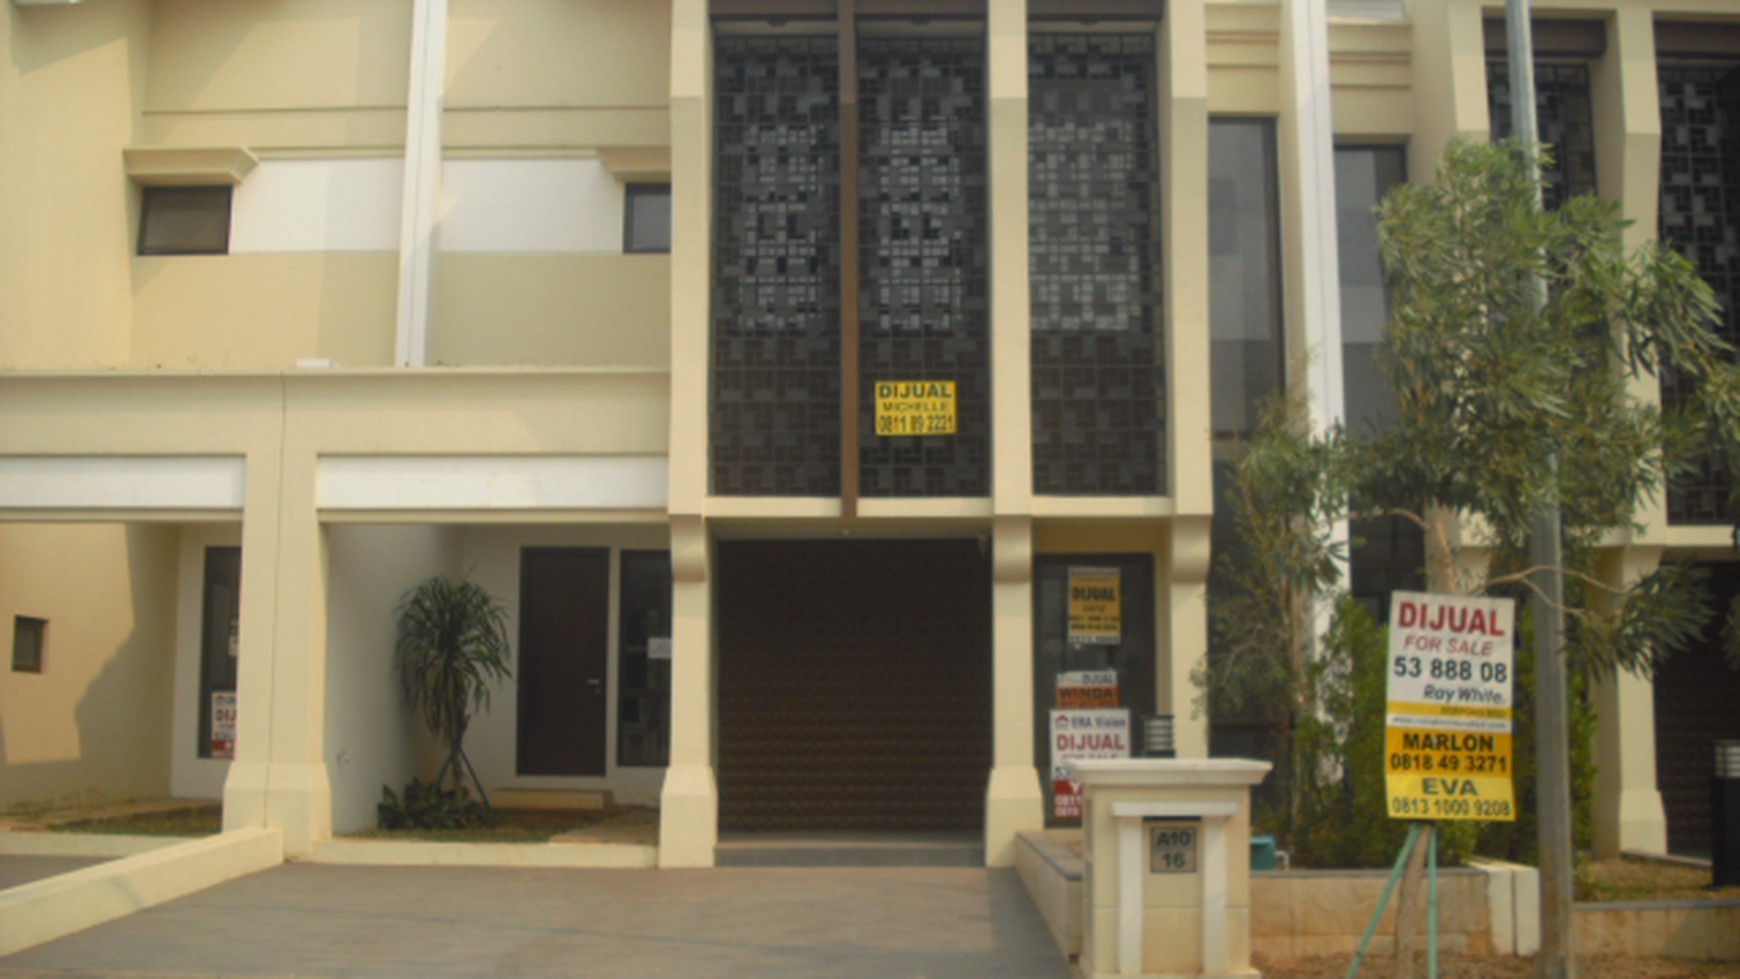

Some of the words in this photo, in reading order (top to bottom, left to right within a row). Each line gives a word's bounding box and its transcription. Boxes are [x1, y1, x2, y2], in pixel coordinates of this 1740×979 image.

[880, 383, 952, 398] DIJUAL
[1398, 602, 1505, 637] DIJUAL
[1404, 635, 1442, 652] FOR
[1446, 638, 1493, 656] SALE
[1393, 657, 1422, 678] 53
[1430, 659, 1472, 681] 888
[1480, 662, 1507, 683] 08
[1056, 733, 1125, 750] DIJUAL
[1402, 733, 1494, 752] MARLON
[1390, 753, 1433, 771] 0818
[1438, 754, 1460, 771] 49
[1466, 755, 1507, 772] 3271
[1422, 777, 1478, 796] EVA
[1392, 798, 1430, 815] 0813
[1433, 799, 1471, 816] 1000
[1156, 831, 1191, 847] A10
[1163, 852, 1185, 868] 16
